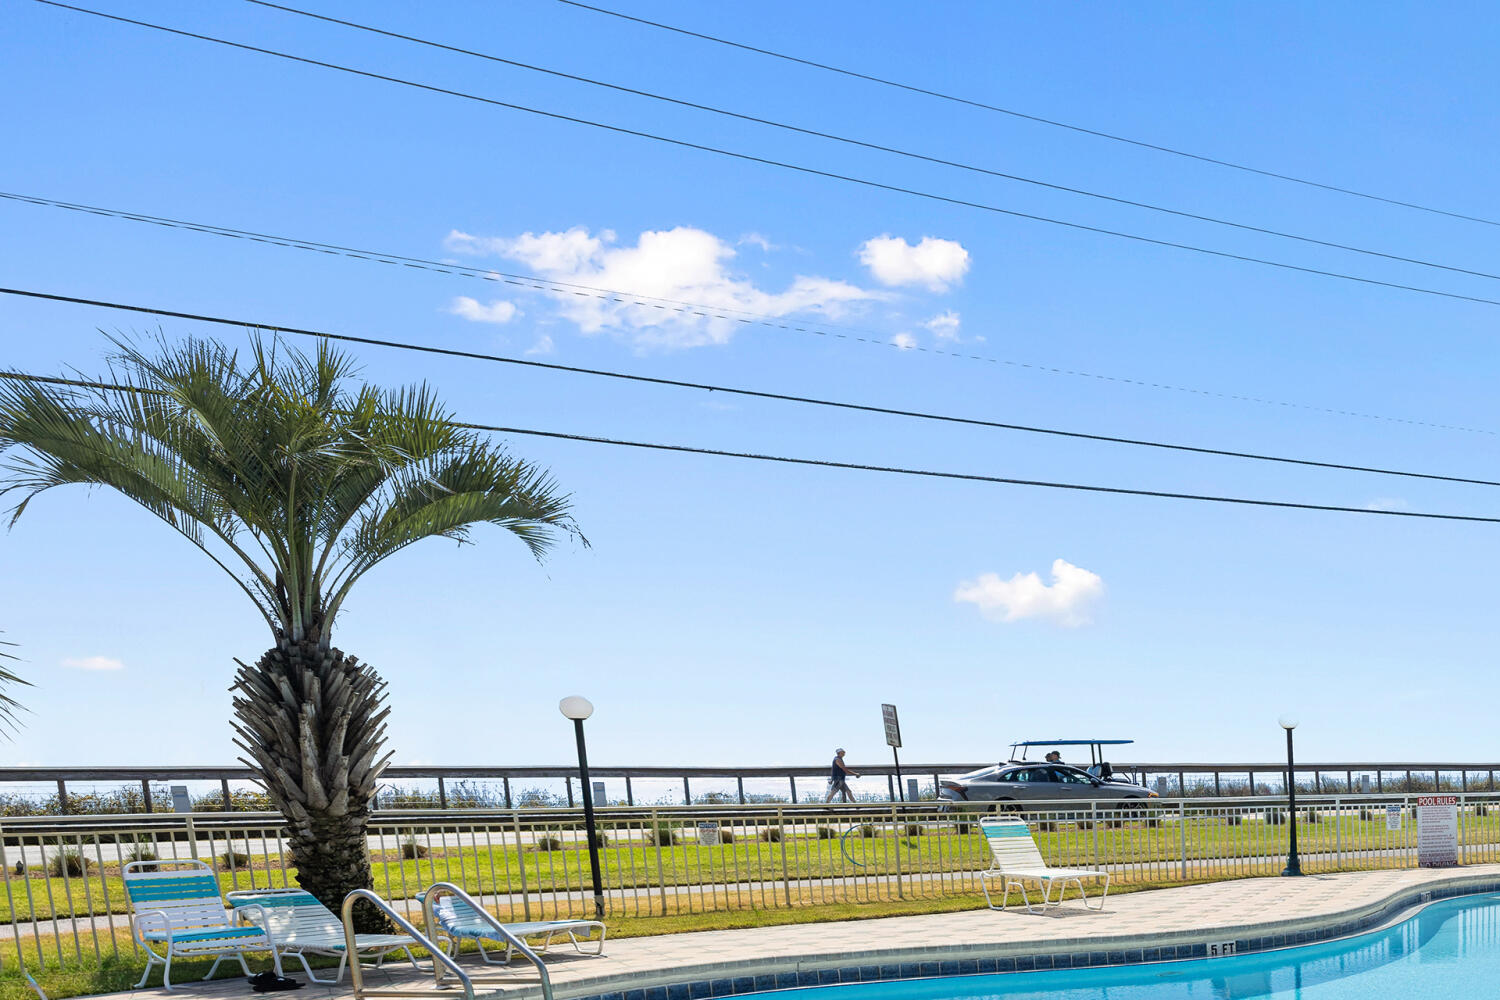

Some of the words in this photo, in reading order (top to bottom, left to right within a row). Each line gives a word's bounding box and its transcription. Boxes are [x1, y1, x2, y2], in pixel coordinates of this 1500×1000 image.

[1418, 797, 1436, 806] POOL
[1437, 796, 1456, 805] RULES
[1210, 944, 1218, 956] 5
